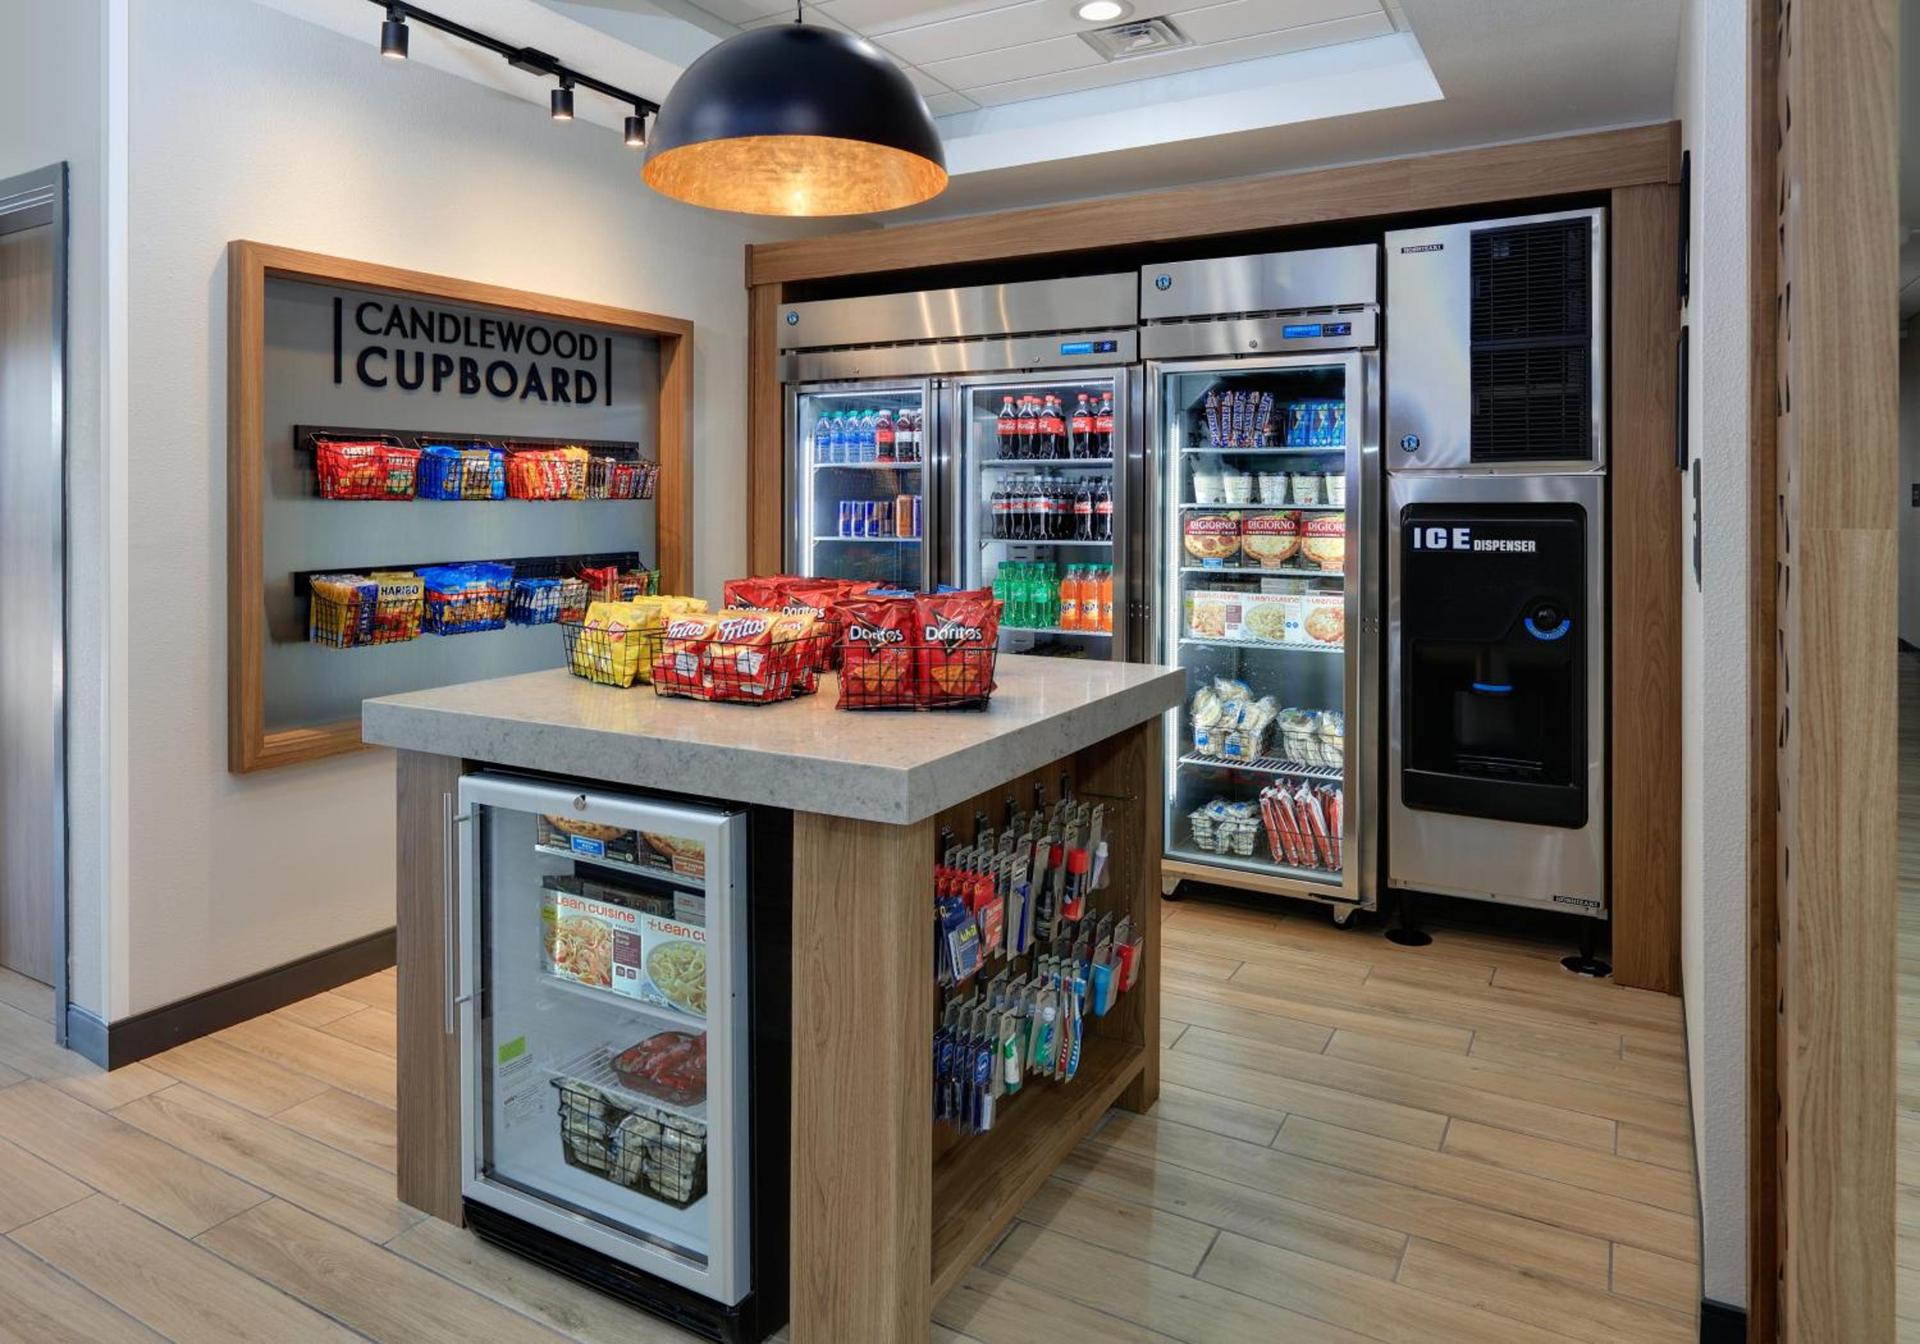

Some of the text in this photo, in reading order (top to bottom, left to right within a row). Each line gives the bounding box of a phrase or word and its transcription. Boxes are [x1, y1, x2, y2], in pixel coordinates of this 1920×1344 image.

[356, 302, 598, 361] CANDLEWOOD
[356, 346, 598, 404] CUPBOARD
[1413, 528, 1536, 552] ICE DISPENSER
[380, 585, 419, 595] HARIBO
[667, 619, 707, 639] Fritos
[718, 615, 767, 642] Fritos
[850, 625, 904, 642] Doritos
[925, 626, 983, 642] Doritos
